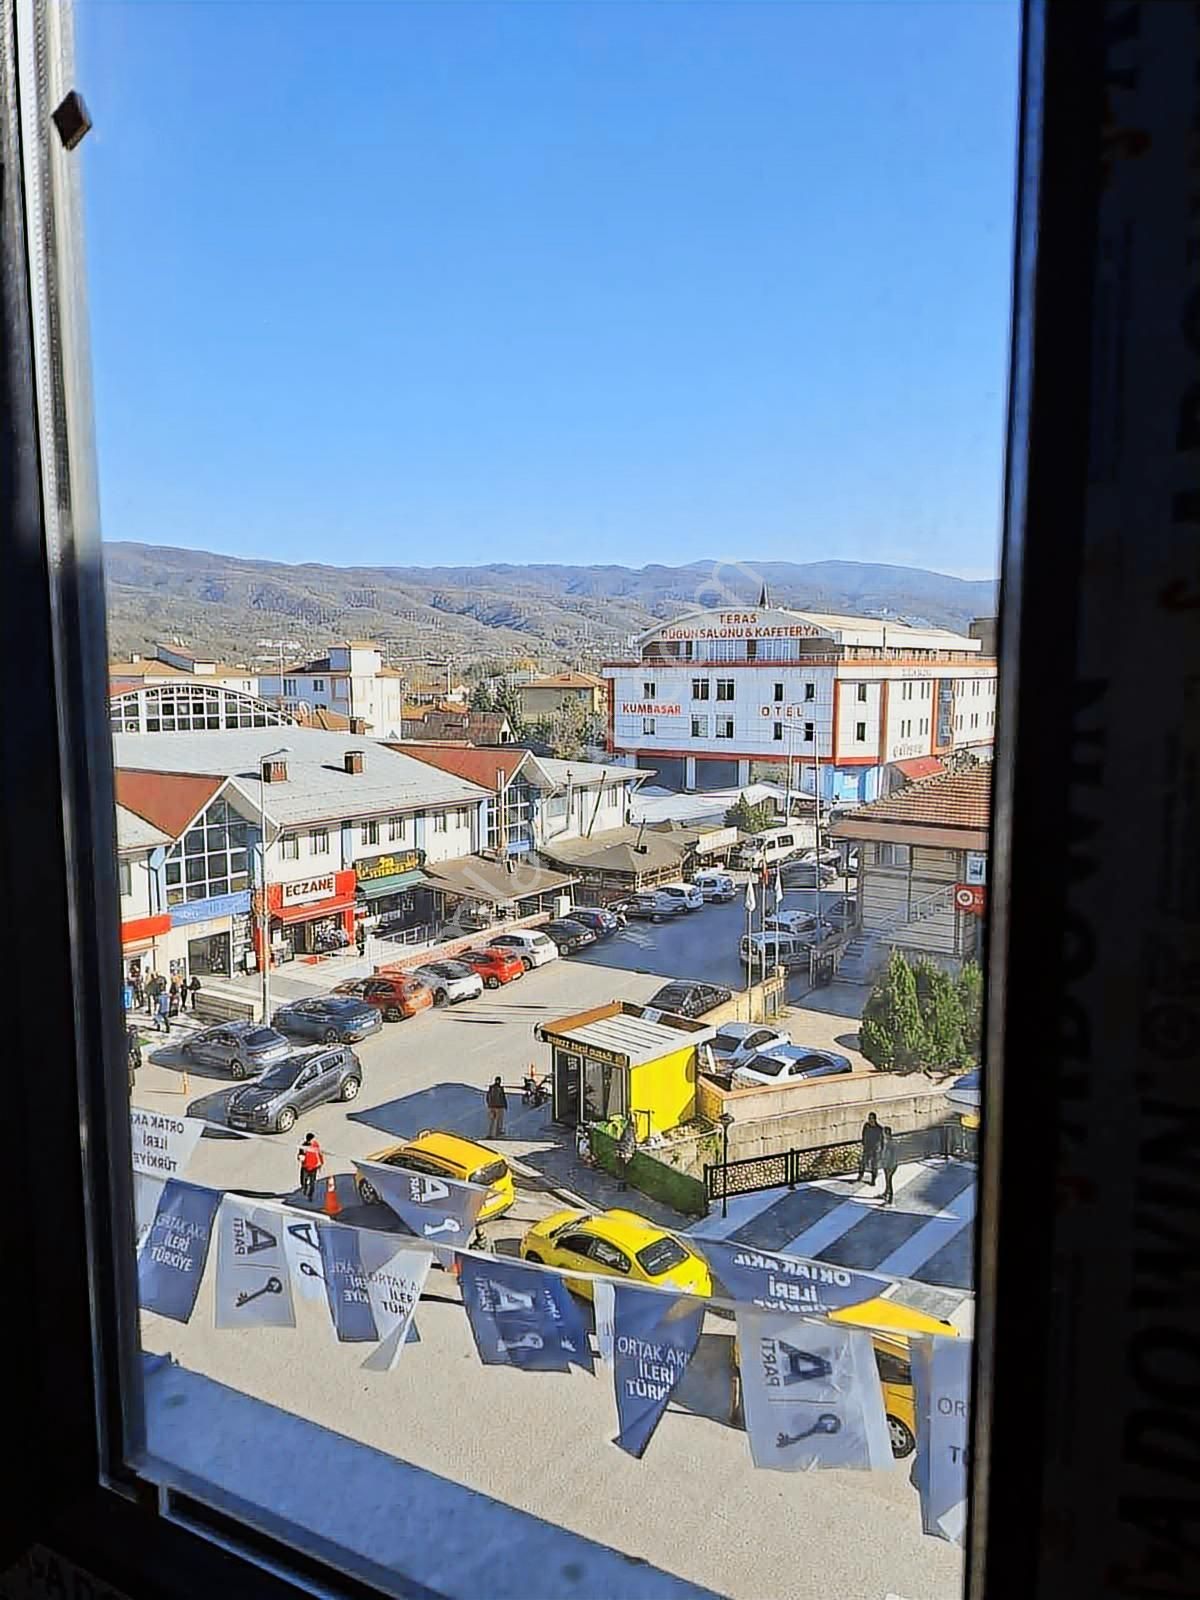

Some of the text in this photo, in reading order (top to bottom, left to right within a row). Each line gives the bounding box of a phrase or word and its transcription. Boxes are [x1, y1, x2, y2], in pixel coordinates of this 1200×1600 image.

[719, 613, 758, 625] TERAS
[699, 628, 744, 639] SALONU
[754, 625, 819, 638] KAFETERYA
[622, 703, 682, 716] KUMBASAR
[761, 705, 804, 718] OTEL
[285, 876, 334, 898] ECZANE
[150, 1245, 194, 1273] TÜRKİYE
[617, 1336, 663, 1362] ORTAK
